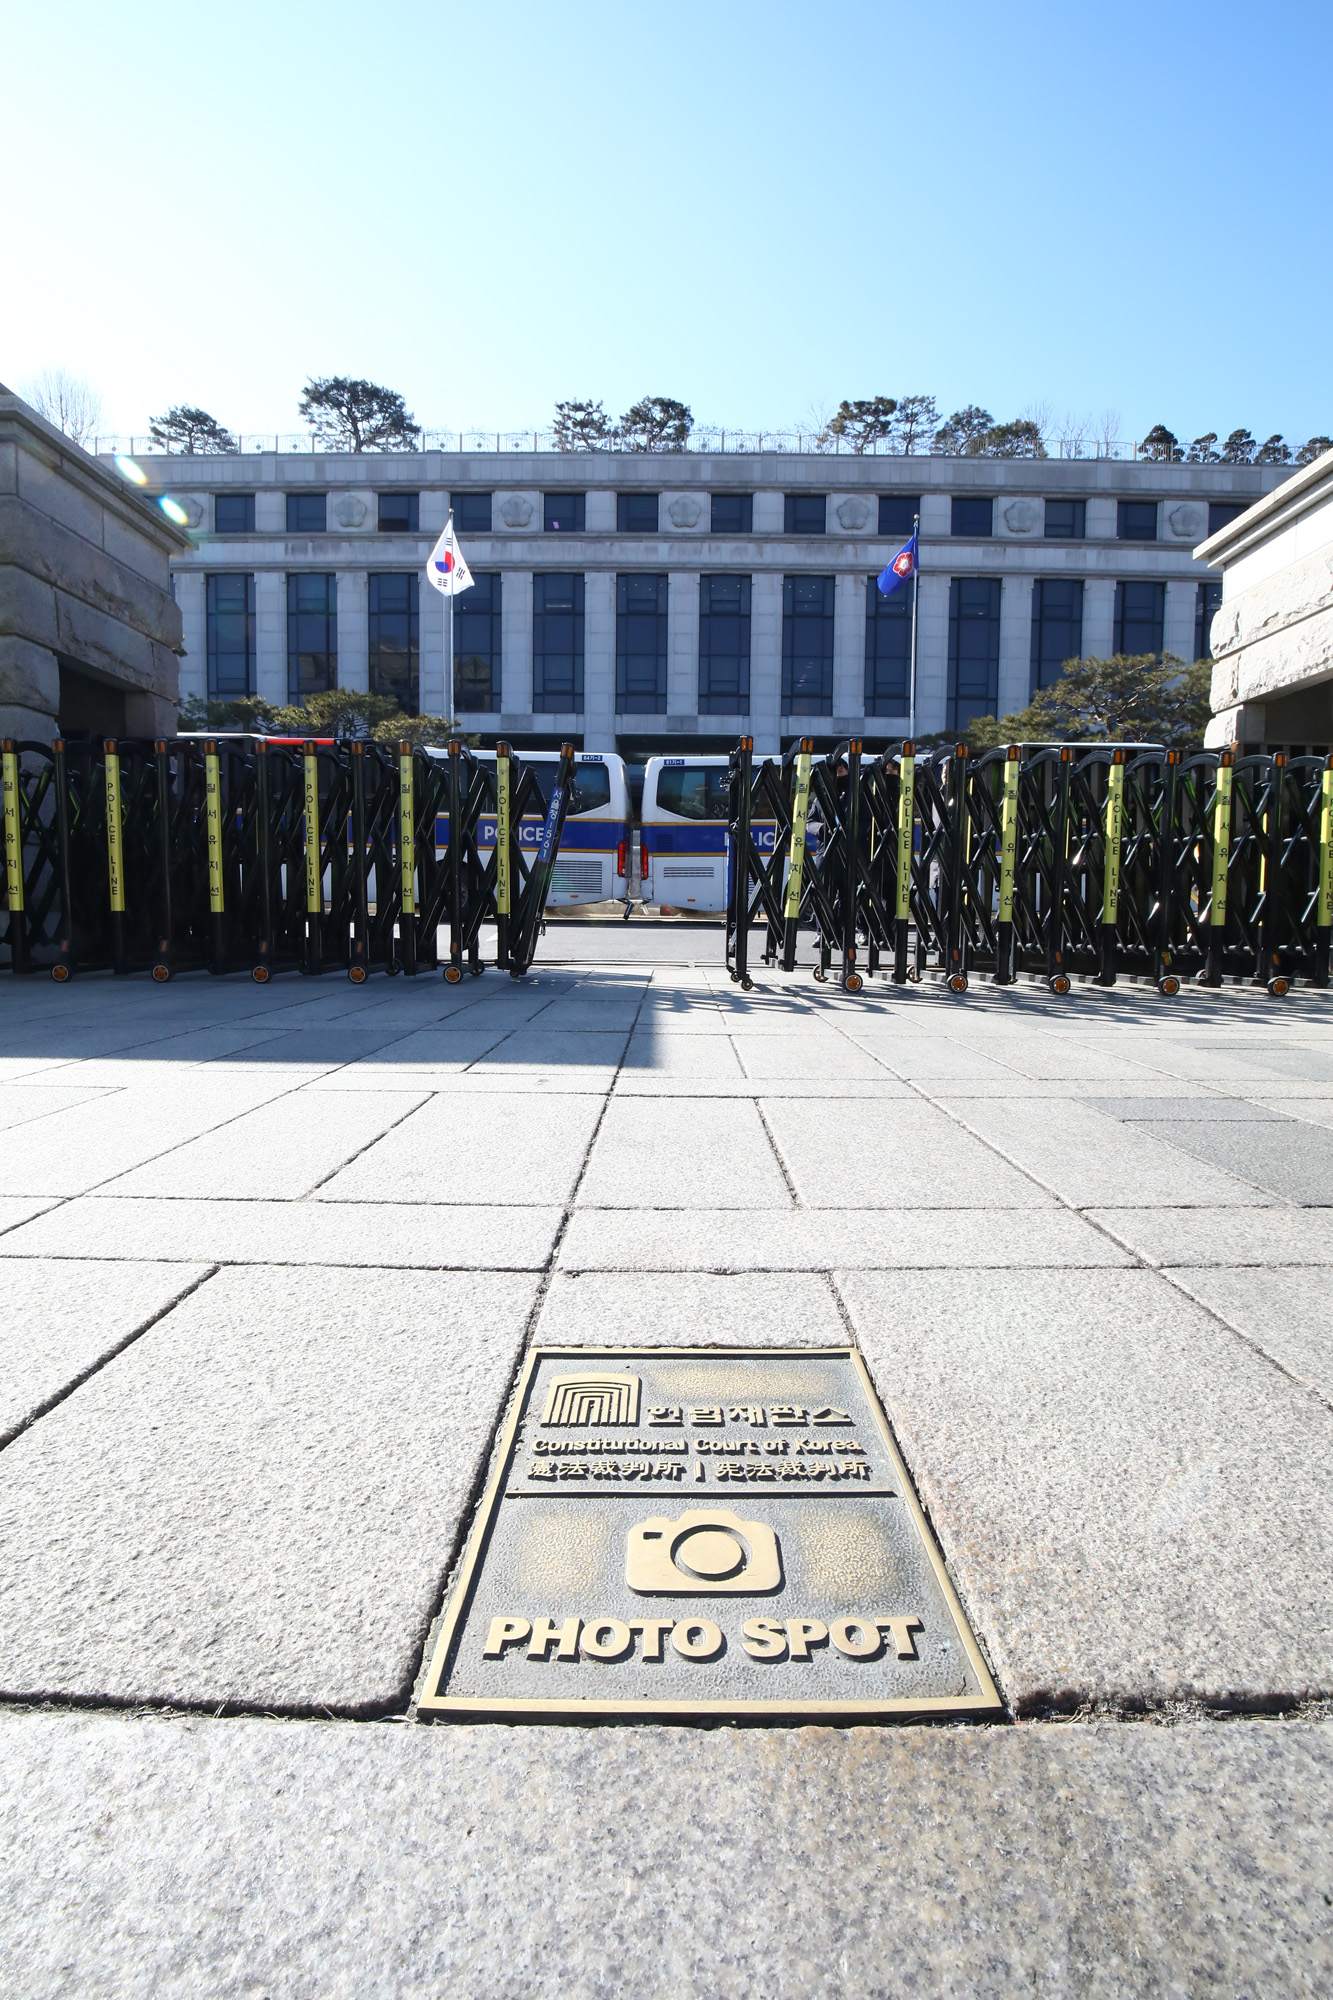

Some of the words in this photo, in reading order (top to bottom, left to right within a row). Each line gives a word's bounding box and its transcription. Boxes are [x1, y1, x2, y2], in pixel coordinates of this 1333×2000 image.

[3, 782, 18, 895] 질서유지선
[106, 783, 115, 843] POLICE
[206, 784, 219, 897] 질서유지선
[305, 784, 314, 844] POLICE
[401, 784, 412, 897] 질서유지선
[484, 826, 545, 841] PICE
[498, 786, 507, 846] POLICE
[789, 783, 807, 901] 질서유지선
[903, 786, 912, 849] POLICE
[1111, 793, 1121, 855] POLICE
[110, 856, 118, 895] LINE
[1004, 790, 1017, 905] 질서유지선
[1109, 867, 1117, 907] LINE
[532, 1438, 686, 1452] Constitutional
[694, 1438, 759, 1452] Court
[764, 1438, 786, 1452] of
[795, 1438, 863, 1452] Korea
[647, 1405, 852, 1425] 헌법재판소
[529, 1460, 683, 1478] 憲法裁判所
[483, 1616, 723, 1658] PHOTO
[741, 1616, 920, 1658] SPOT
